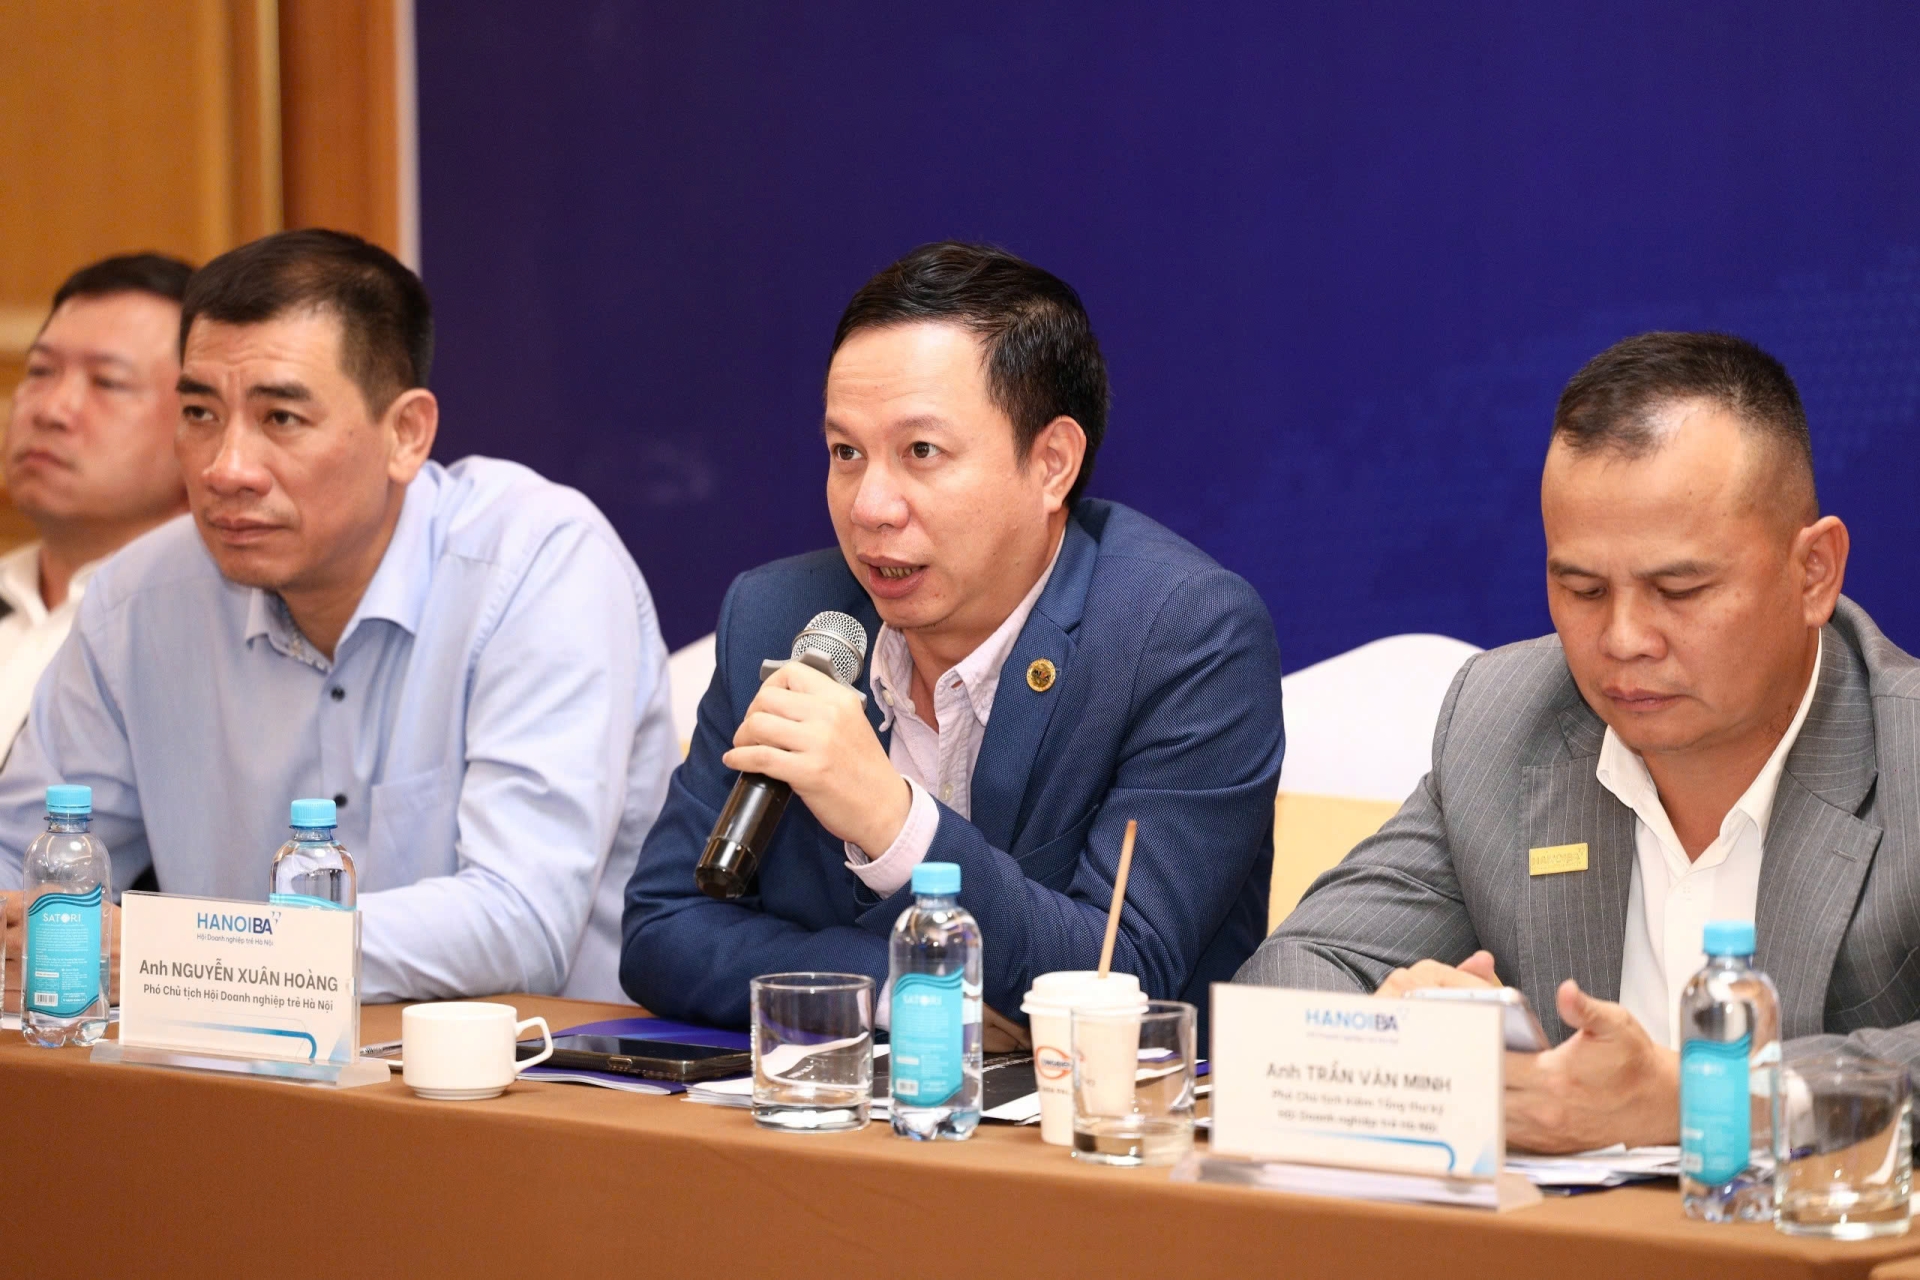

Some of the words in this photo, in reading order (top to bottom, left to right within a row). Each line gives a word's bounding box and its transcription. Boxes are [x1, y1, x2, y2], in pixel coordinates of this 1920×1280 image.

[43, 913, 82, 923] SATORI
[197, 912, 273, 935] HANOIBA
[207, 933, 225, 942] Doanh
[139, 959, 168, 976] Anh
[171, 958, 234, 982] NGUYỄN
[237, 965, 280, 986] XUÂN
[284, 969, 338, 992] HOÀNG
[143, 983, 161, 994] Phó
[163, 985, 181, 996] Chủ
[183, 987, 201, 1000] tịch
[203, 989, 219, 1002] Hội
[220, 991, 250, 1003] Doanh
[252, 993, 285, 1008] nghiệp
[302, 997, 316, 1009] Hà
[317, 1000, 334, 1013] Nội
